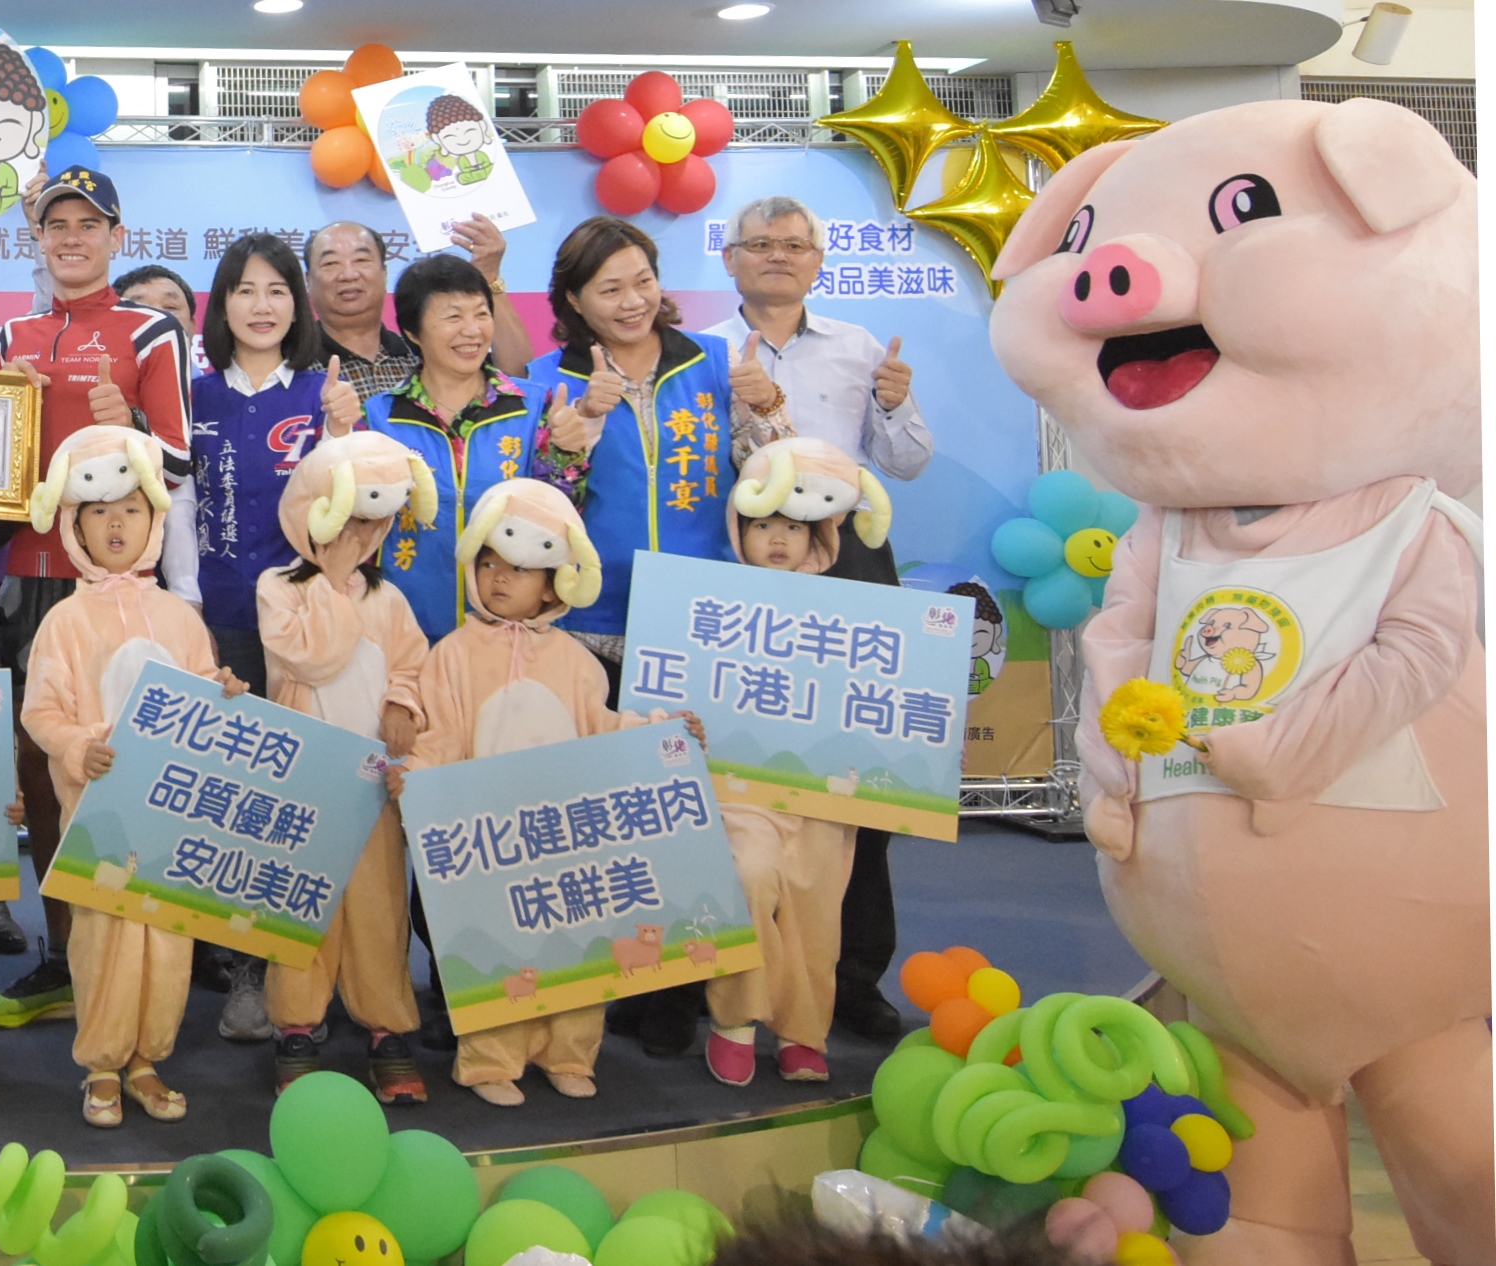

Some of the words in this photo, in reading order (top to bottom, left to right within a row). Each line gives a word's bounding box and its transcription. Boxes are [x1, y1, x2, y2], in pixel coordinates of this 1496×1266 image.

[664, 408, 701, 512] 黃千宴
[691, 600, 901, 675] 彰化羊肉
[132, 688, 300, 778] 彰化羊肉
[148, 764, 316, 851] 品質優鮮
[421, 778, 709, 880] 彰化健康豬肉
[166, 838, 332, 920] 安心美味
[509, 857, 660, 930] 味鮮美
